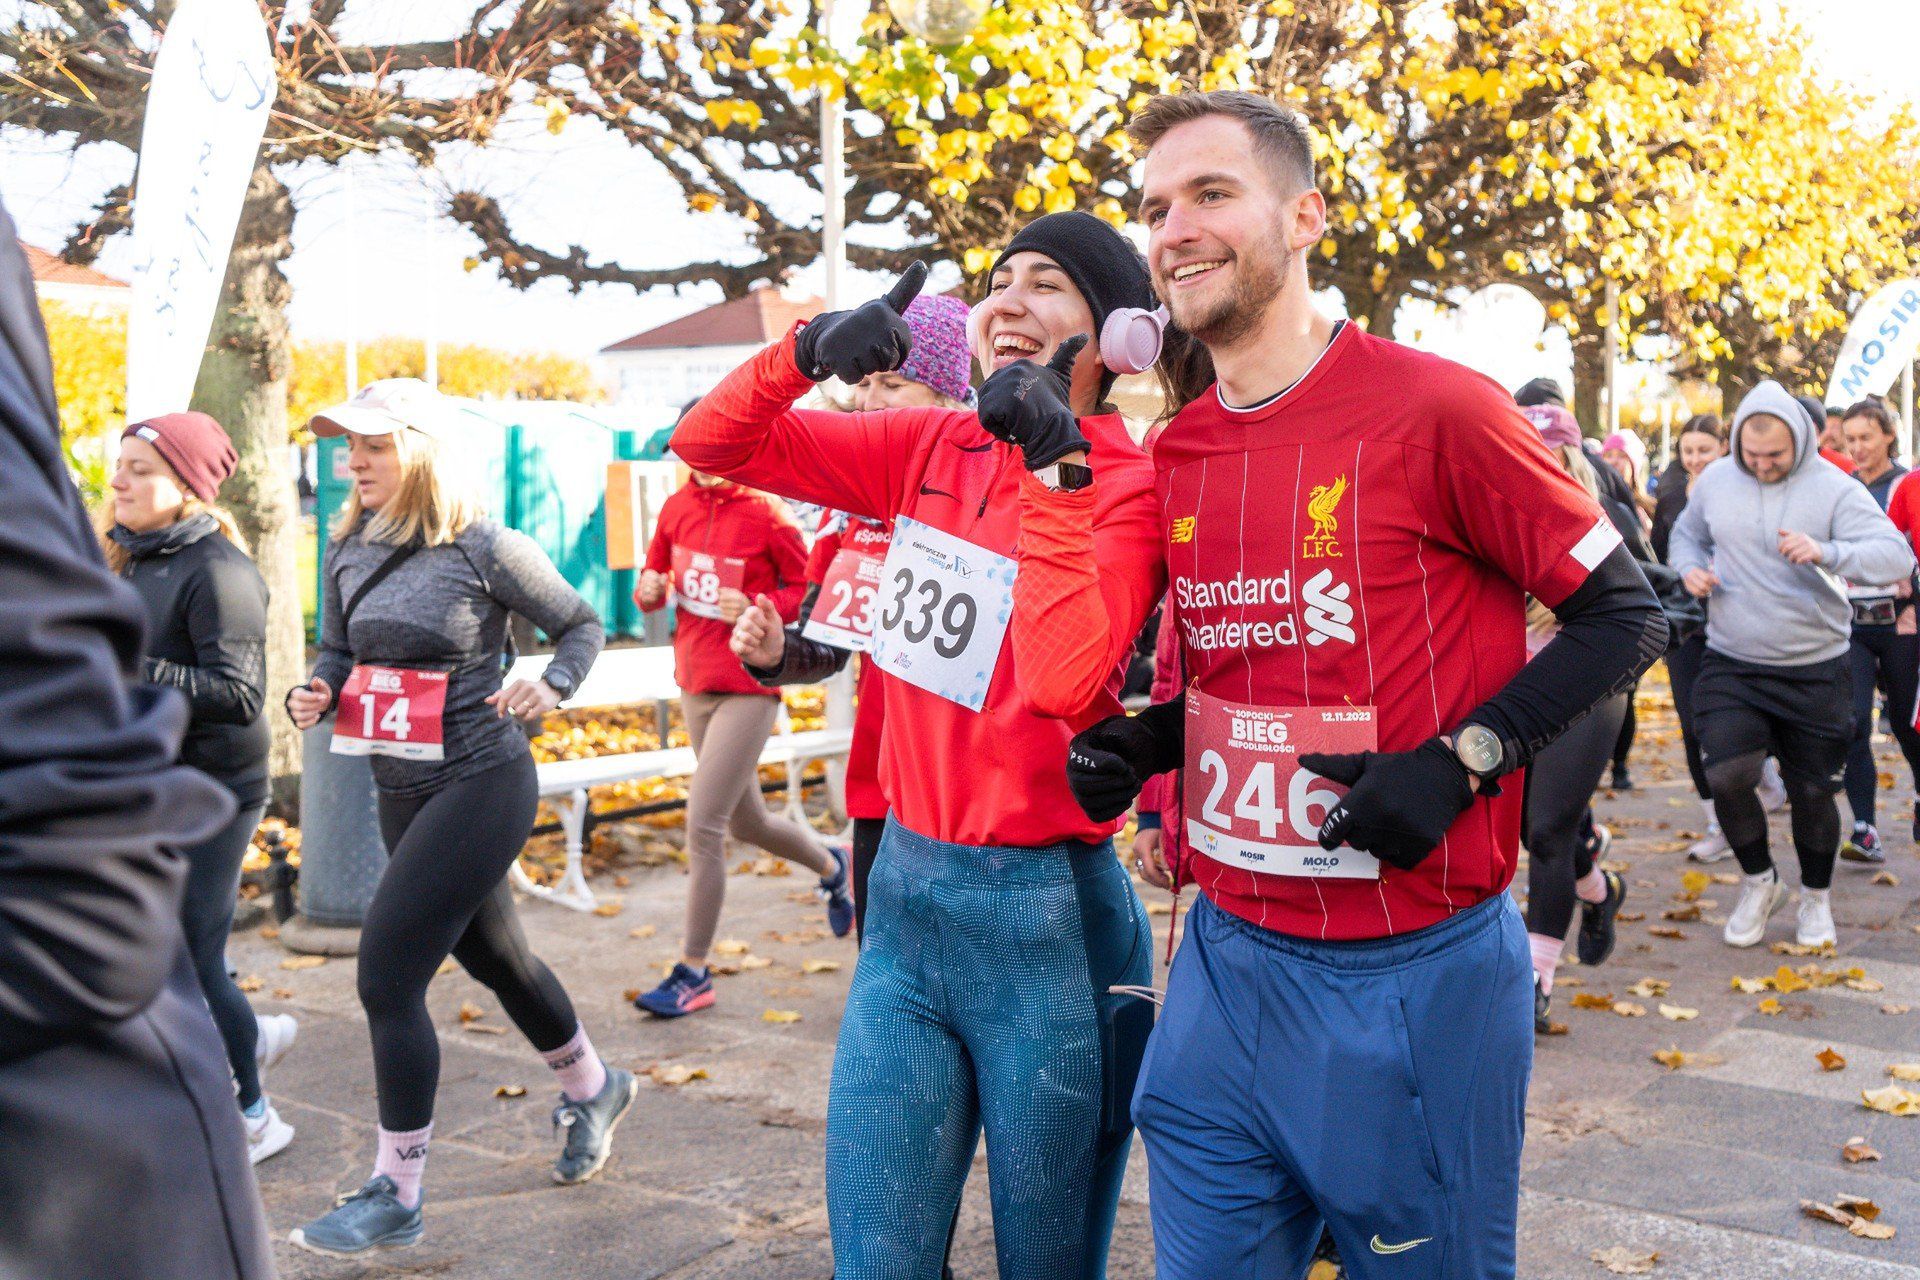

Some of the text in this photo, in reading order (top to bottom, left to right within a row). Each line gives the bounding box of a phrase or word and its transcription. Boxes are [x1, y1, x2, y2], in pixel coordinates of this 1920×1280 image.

[1840, 289, 1920, 398] MOSIR
[1302, 541, 1343, 559] L.F.C.
[683, 568, 720, 604] 68
[1176, 569, 1291, 610] Standard
[826, 579, 878, 633] 23
[882, 568, 977, 659] 339
[1182, 613, 1299, 651] Chartered
[359, 693, 412, 740] 14
[1231, 717, 1287, 743] BIEG
[1235, 709, 1273, 721] SOPOCKI
[1321, 712, 1371, 722] 12.11.2023
[1199, 749, 1341, 843] 246
[1240, 850, 1265, 861] MOSIR
[1302, 857, 1340, 866] MOLO
